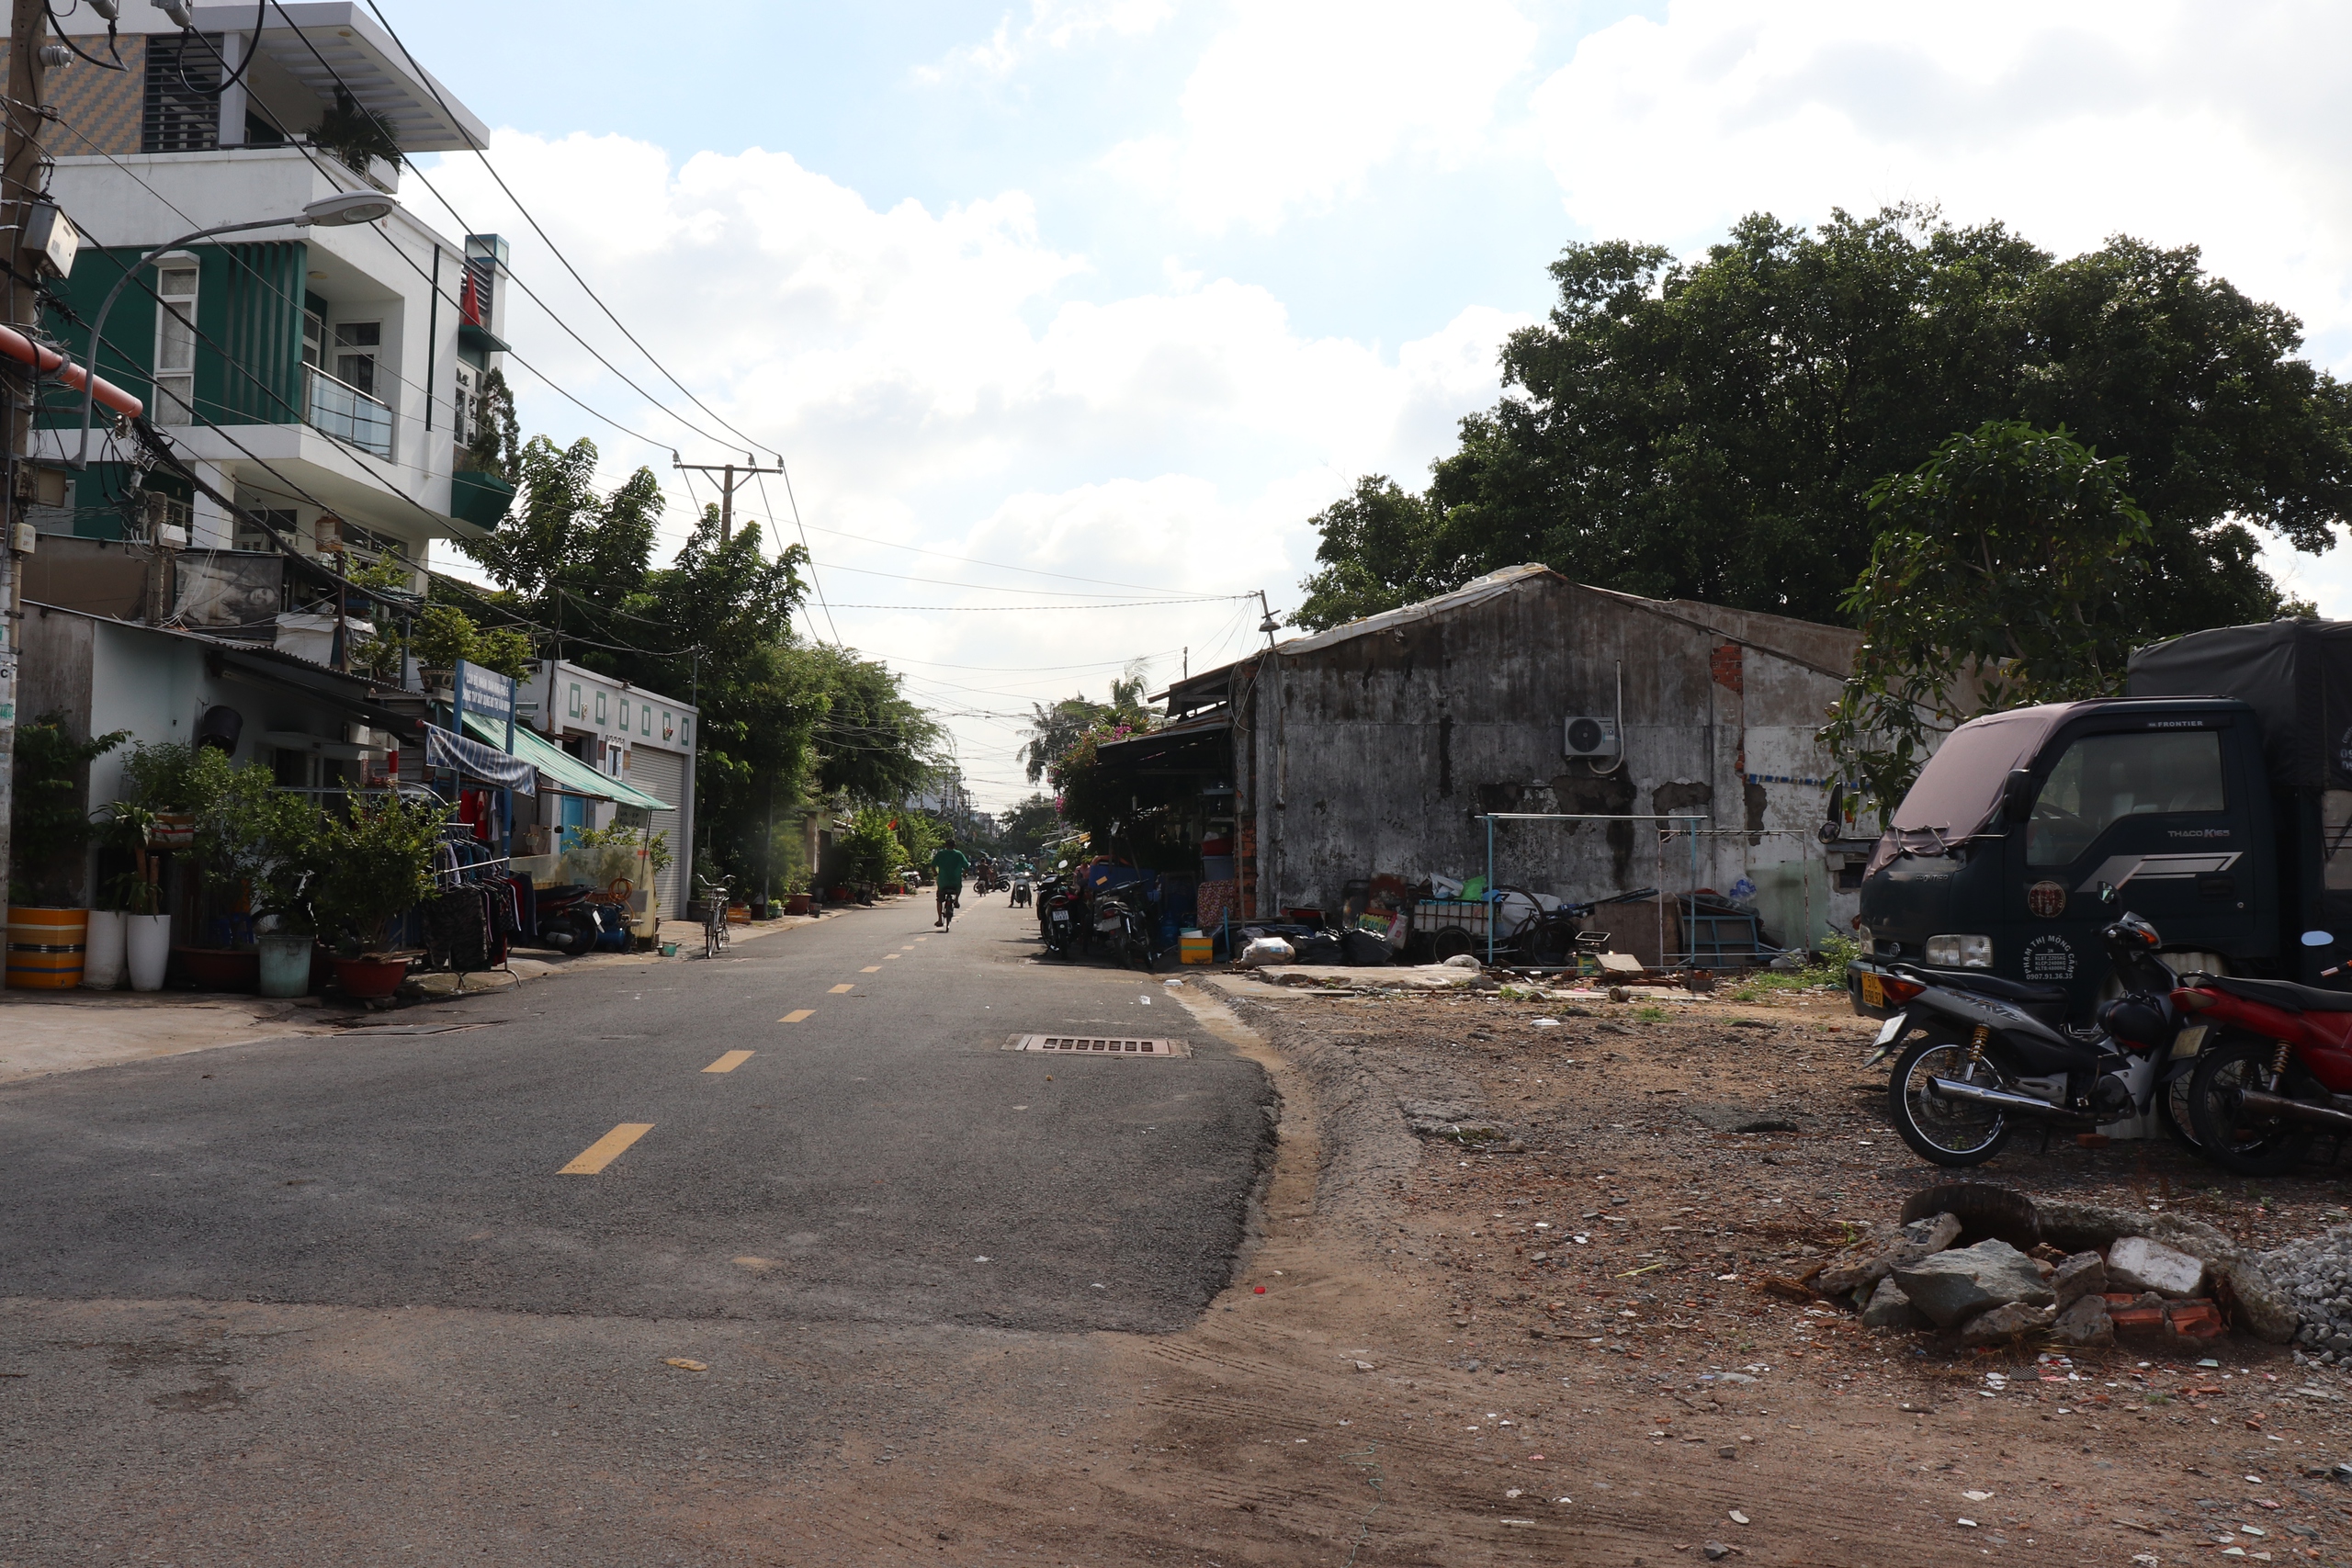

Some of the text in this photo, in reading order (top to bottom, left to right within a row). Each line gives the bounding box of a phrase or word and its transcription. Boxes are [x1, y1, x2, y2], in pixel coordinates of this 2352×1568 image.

[2167, 829, 2231, 838] THACO K165
[1916, 874, 1950, 883] FRONTIER
[2023, 947, 2033, 974] PHẠM
[2030, 936, 2046, 948] THỊ
[2047, 934, 2072, 953] MỘNG
[1867, 975, 1878, 989] 51C
